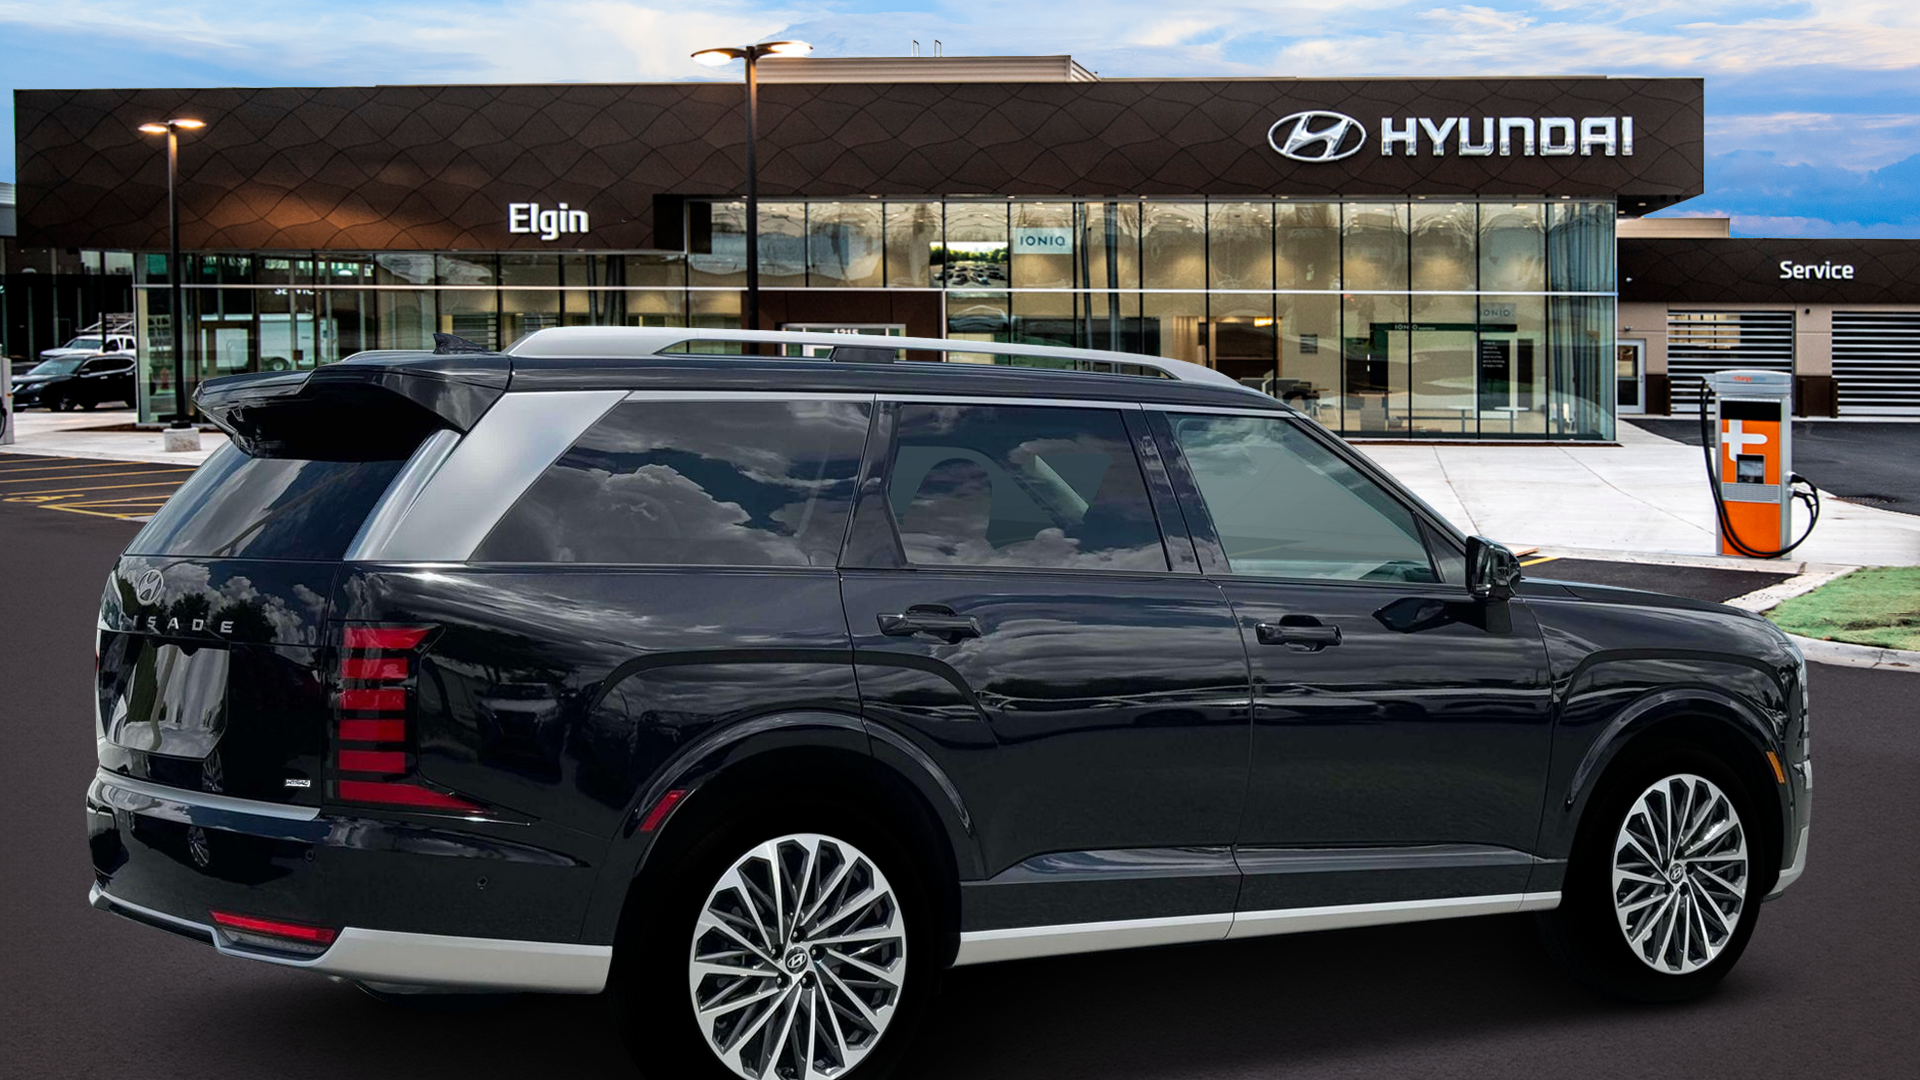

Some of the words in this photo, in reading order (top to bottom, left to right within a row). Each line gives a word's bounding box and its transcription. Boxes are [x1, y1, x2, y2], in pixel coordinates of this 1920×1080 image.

[1381, 116, 1634, 157] HYUNDAI
[508, 202, 590, 241] Elgin
[1019, 235, 1066, 247] IONIQ
[1779, 260, 1855, 279] Service
